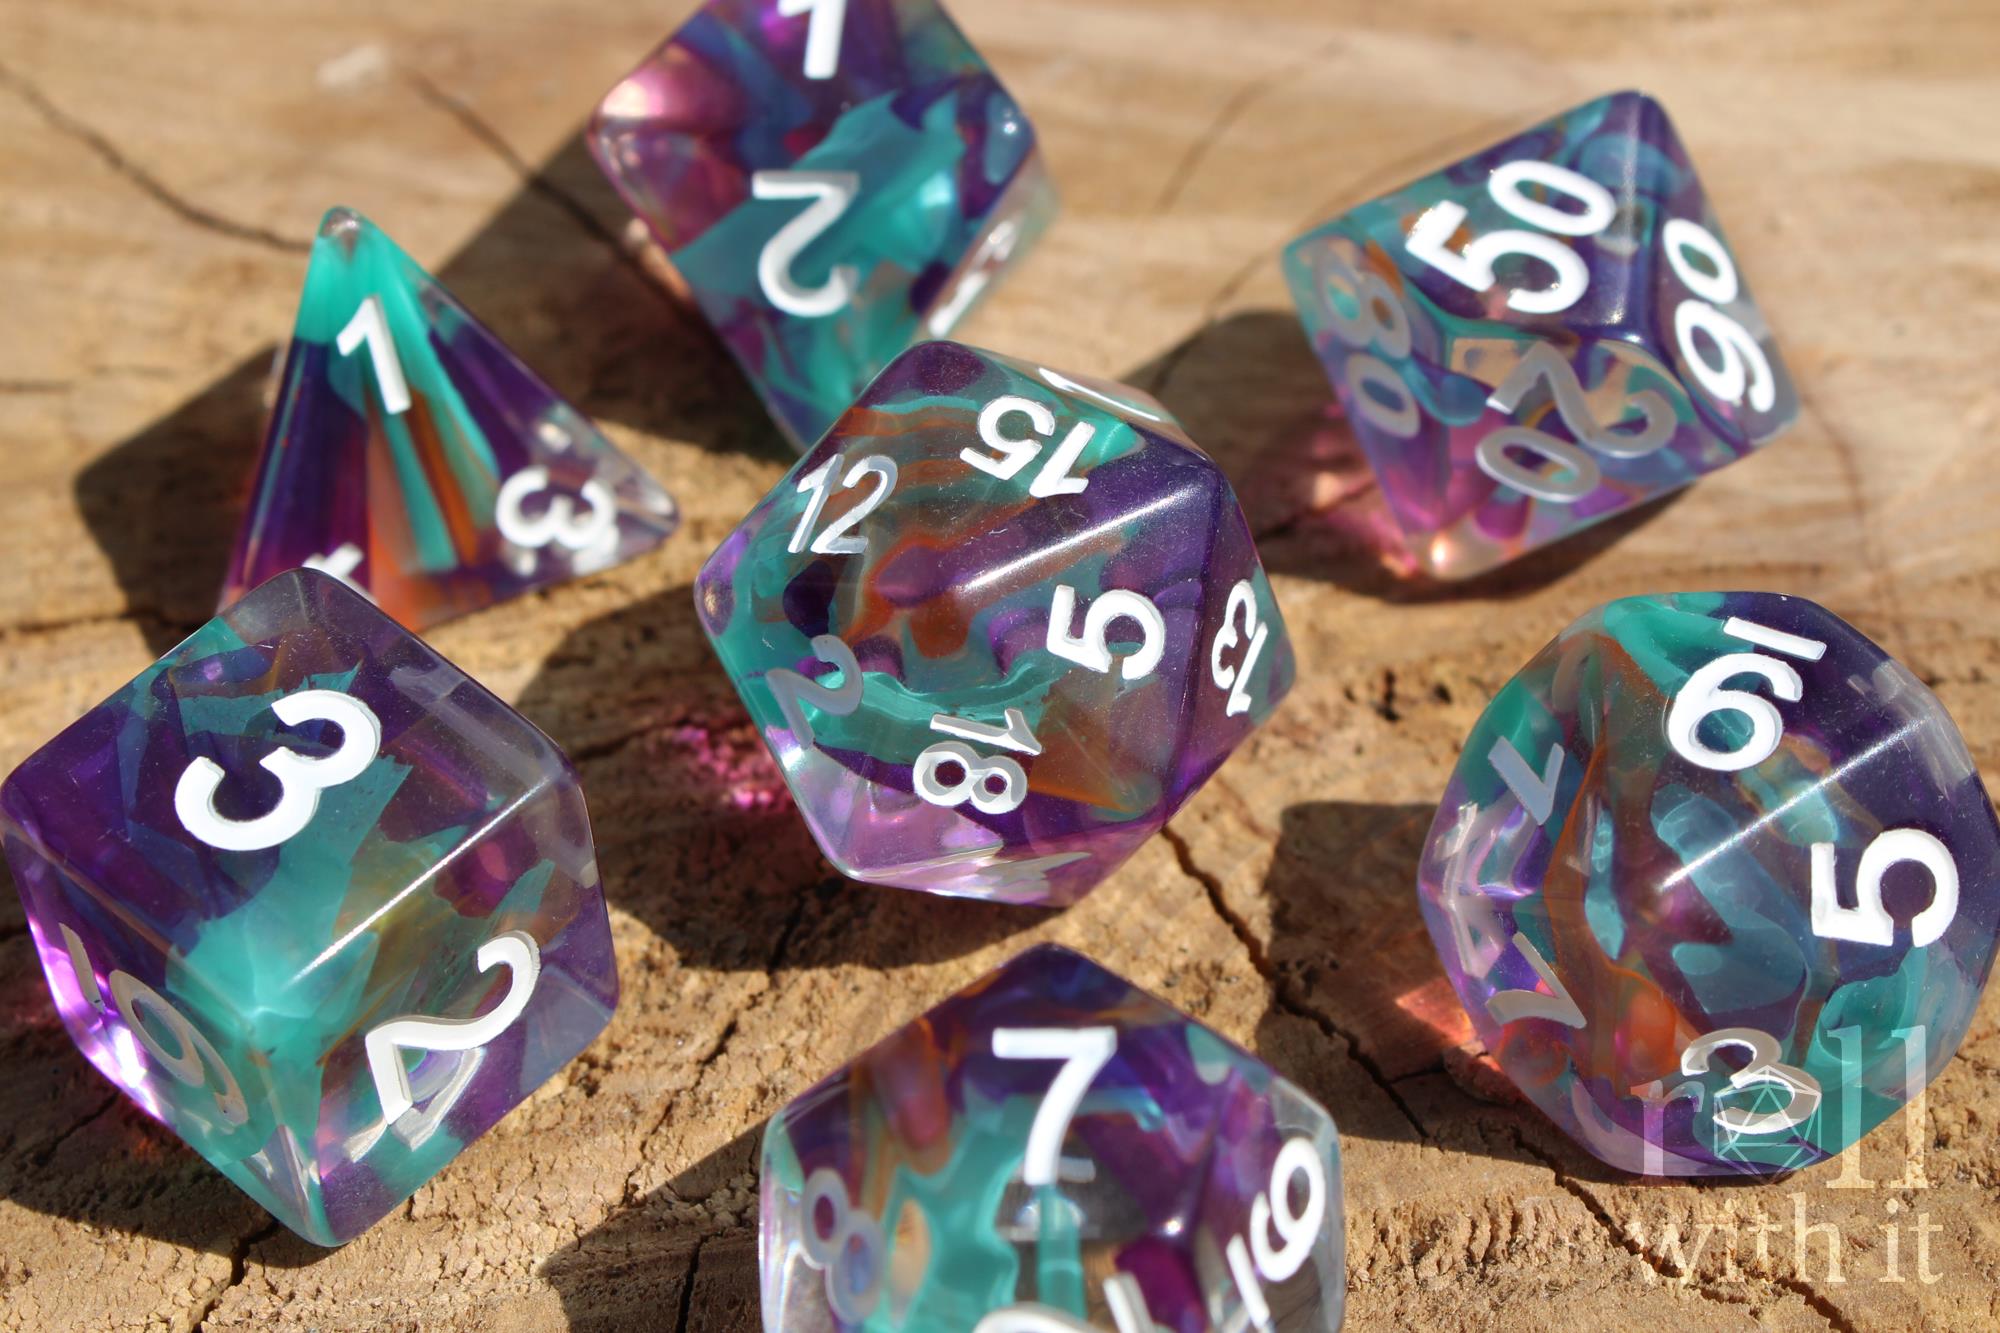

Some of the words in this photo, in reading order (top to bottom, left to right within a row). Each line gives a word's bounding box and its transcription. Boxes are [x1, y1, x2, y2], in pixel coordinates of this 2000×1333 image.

[752, 171, 859, 317] 2
[1405, 160, 1615, 313] 50
[336, 295, 411, 415] 1
[787, 453, 898, 554] 12
[960, 395, 1096, 498] 15
[496, 465, 618, 549] 3
[1047, 584, 1165, 679] 5
[1211, 579, 1268, 717] 13
[766, 635, 863, 749] 2
[175, 690, 381, 851] 3
[913, 708, 1042, 815] 18
[1811, 828, 1959, 948] 5
[365, 930, 541, 1125] 2
[1680, 1027, 1821, 1134] 3
[993, 1026, 1117, 1186] 7
[802, 1167, 888, 1325] 8
